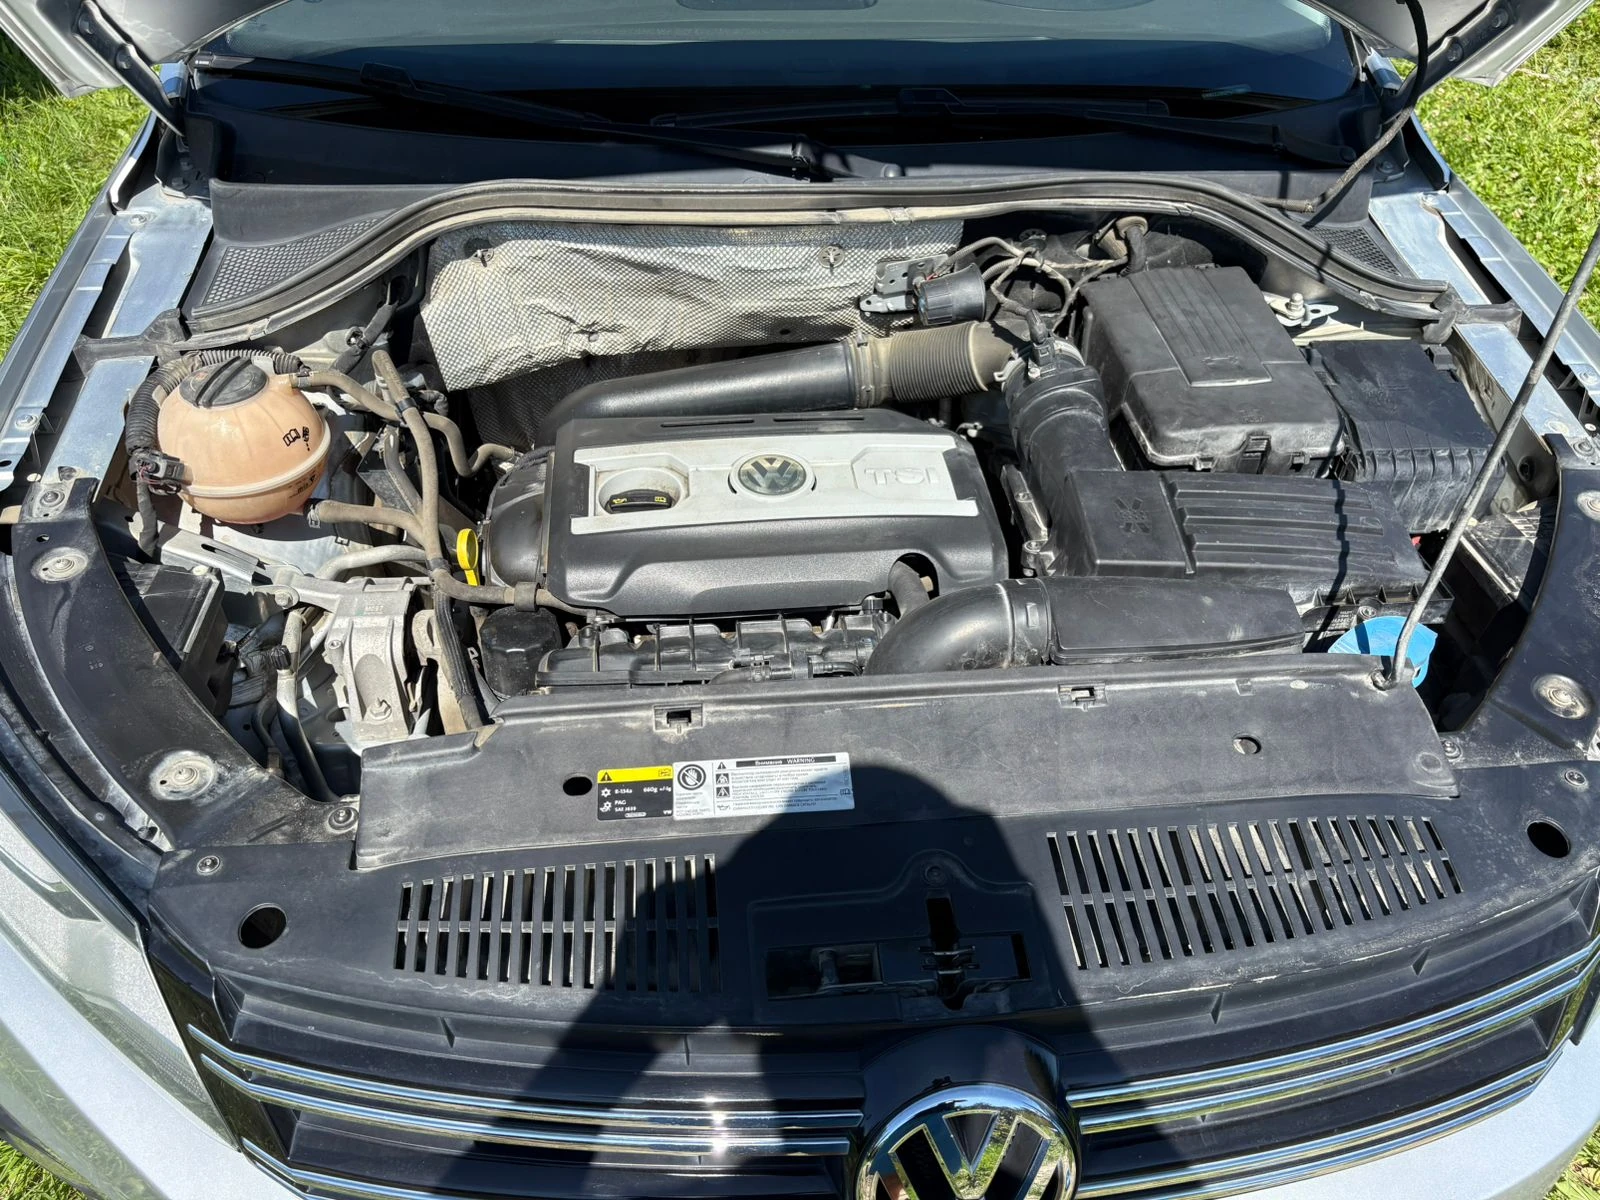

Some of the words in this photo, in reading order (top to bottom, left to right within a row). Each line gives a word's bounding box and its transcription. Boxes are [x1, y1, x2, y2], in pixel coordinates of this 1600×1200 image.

[738, 454, 807, 496] VW
[864, 467, 939, 486] TSI
[786, 757, 816, 765] WARNING
